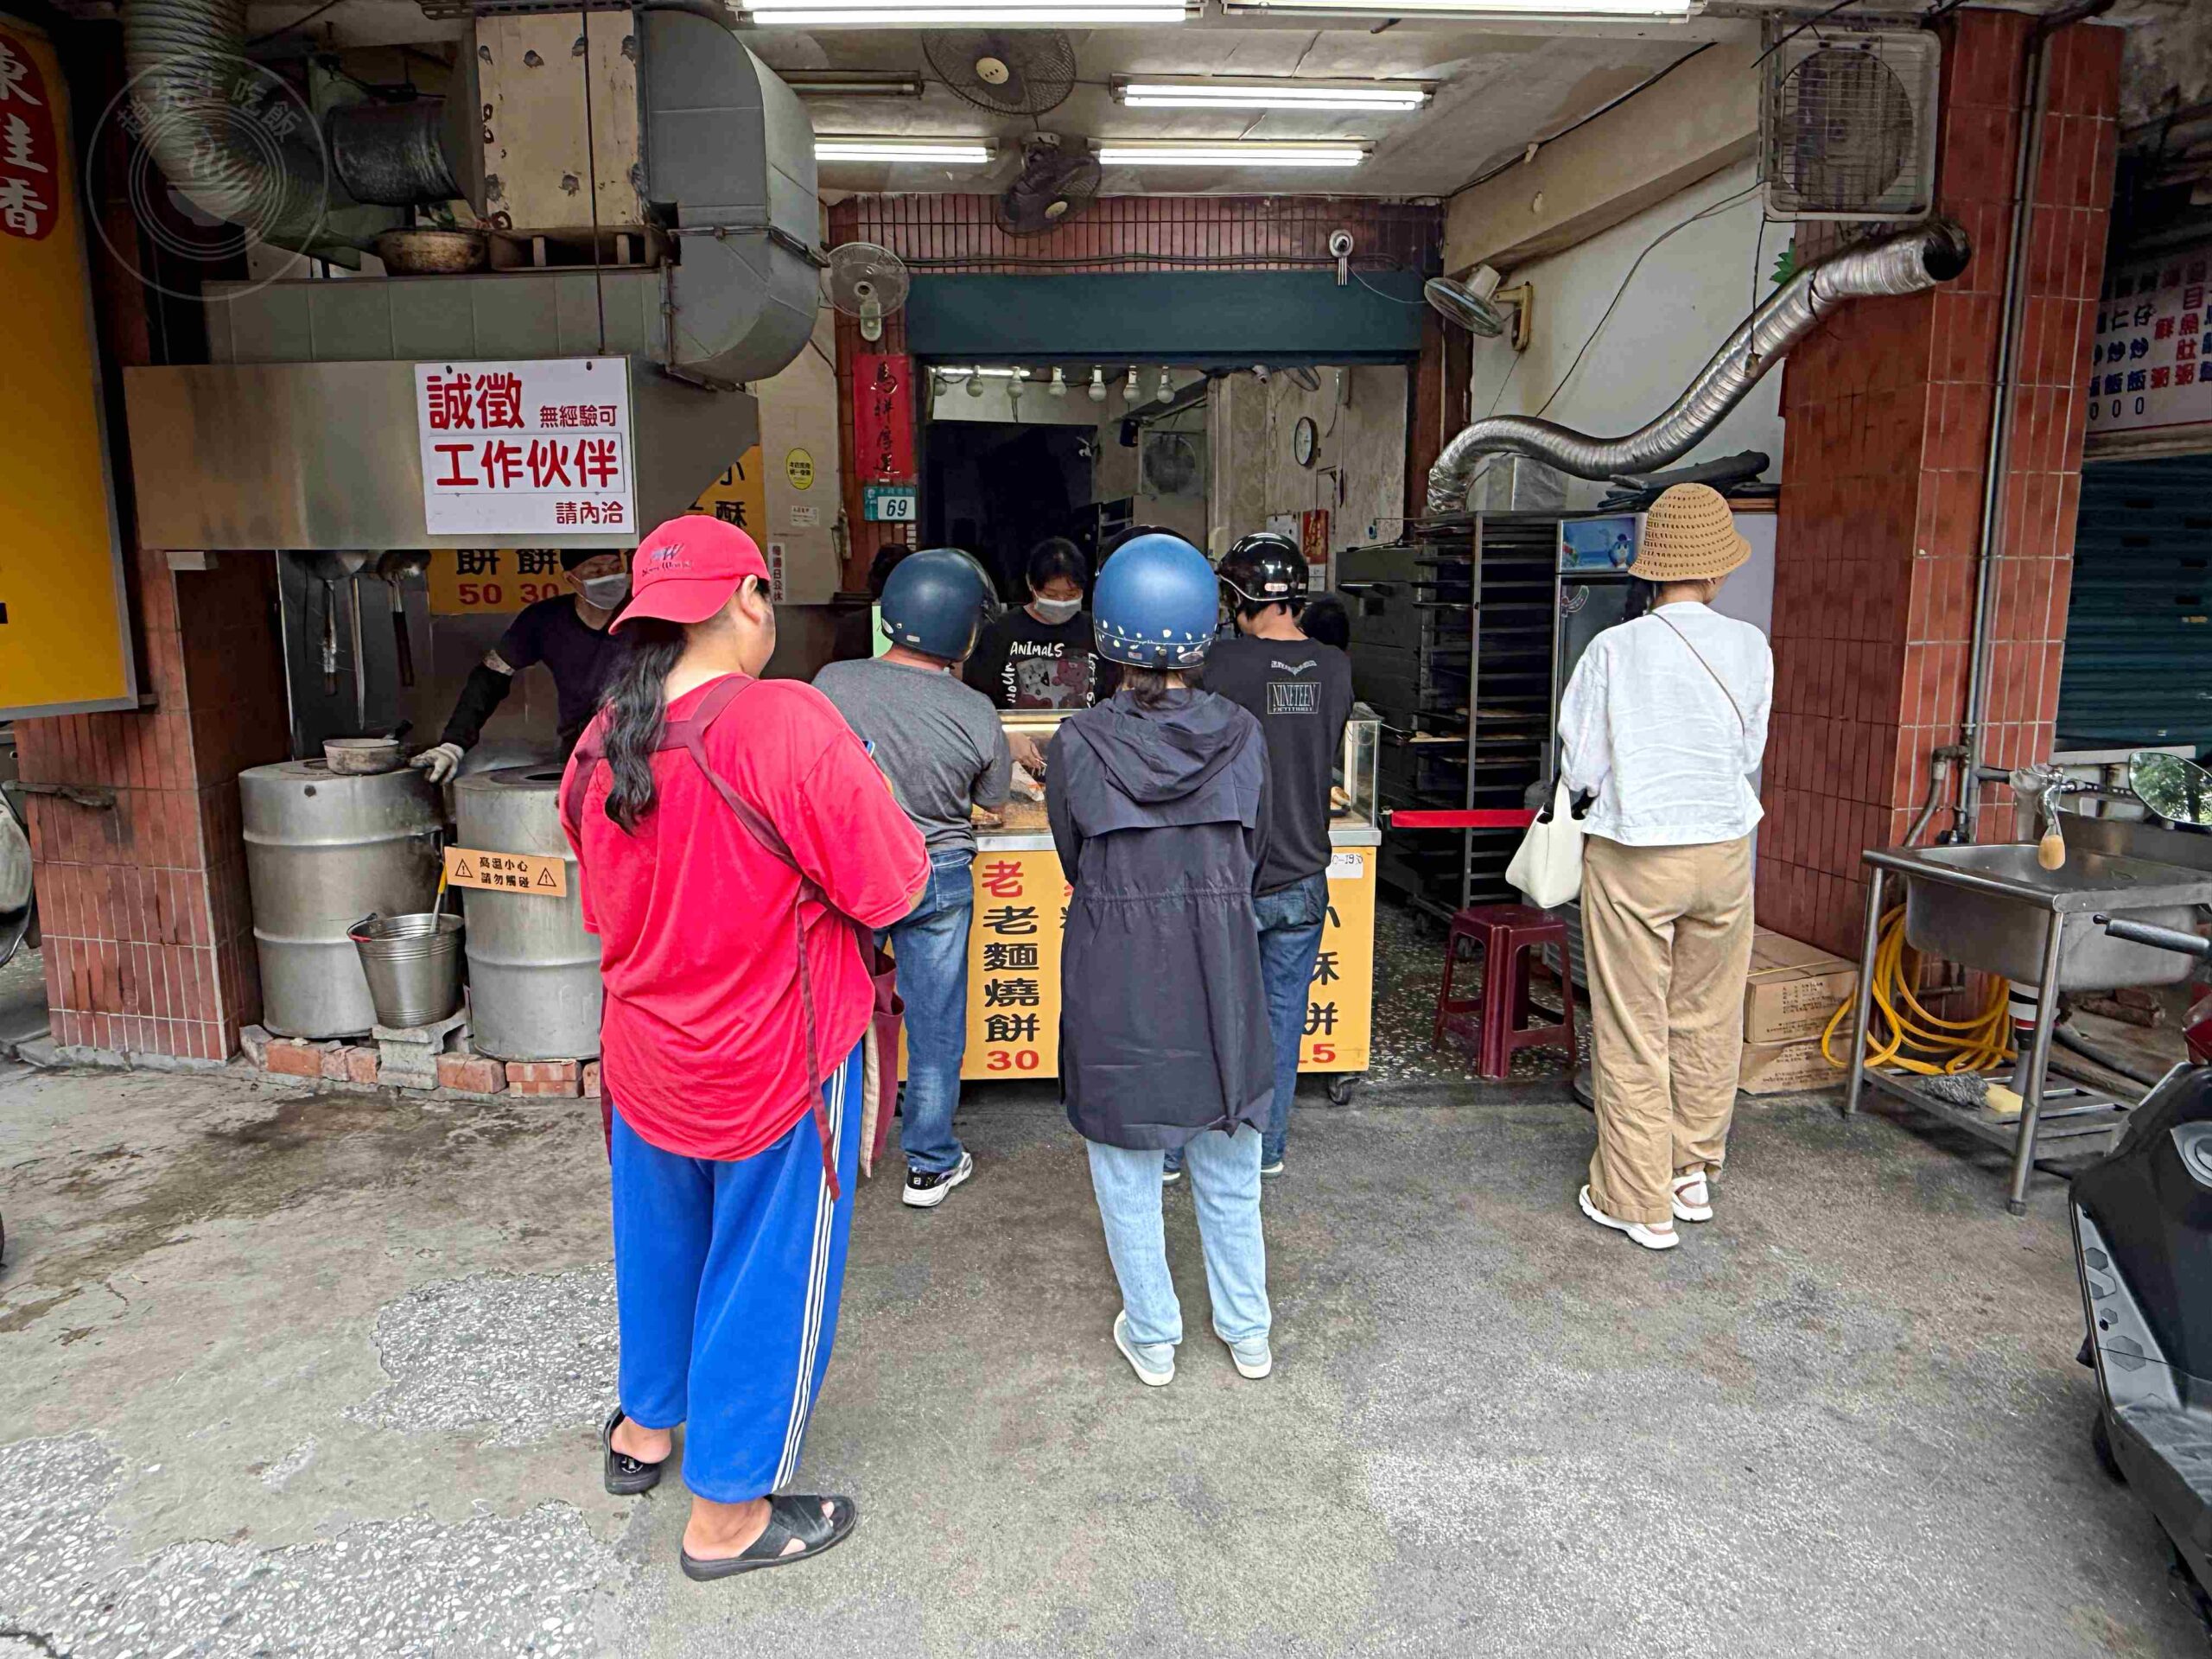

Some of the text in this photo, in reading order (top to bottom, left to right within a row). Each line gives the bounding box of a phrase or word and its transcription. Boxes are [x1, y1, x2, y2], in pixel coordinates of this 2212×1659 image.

[427, 372, 618, 429] 誠徵 無經驗可
[435, 439, 620, 489] 工作伙伴
[556, 501, 624, 524] 請內洽
[887, 499, 907, 517] 69
[459, 583, 502, 605] 50
[520, 583, 559, 605] 30
[1273, 683, 1317, 708] NINETEEN
[480, 856, 529, 873] 高溫小心
[480, 872, 531, 888] 請勿觸碰
[982, 905, 1041, 1043] 老麵燒餅
[986, 1050, 1040, 1071] 30
